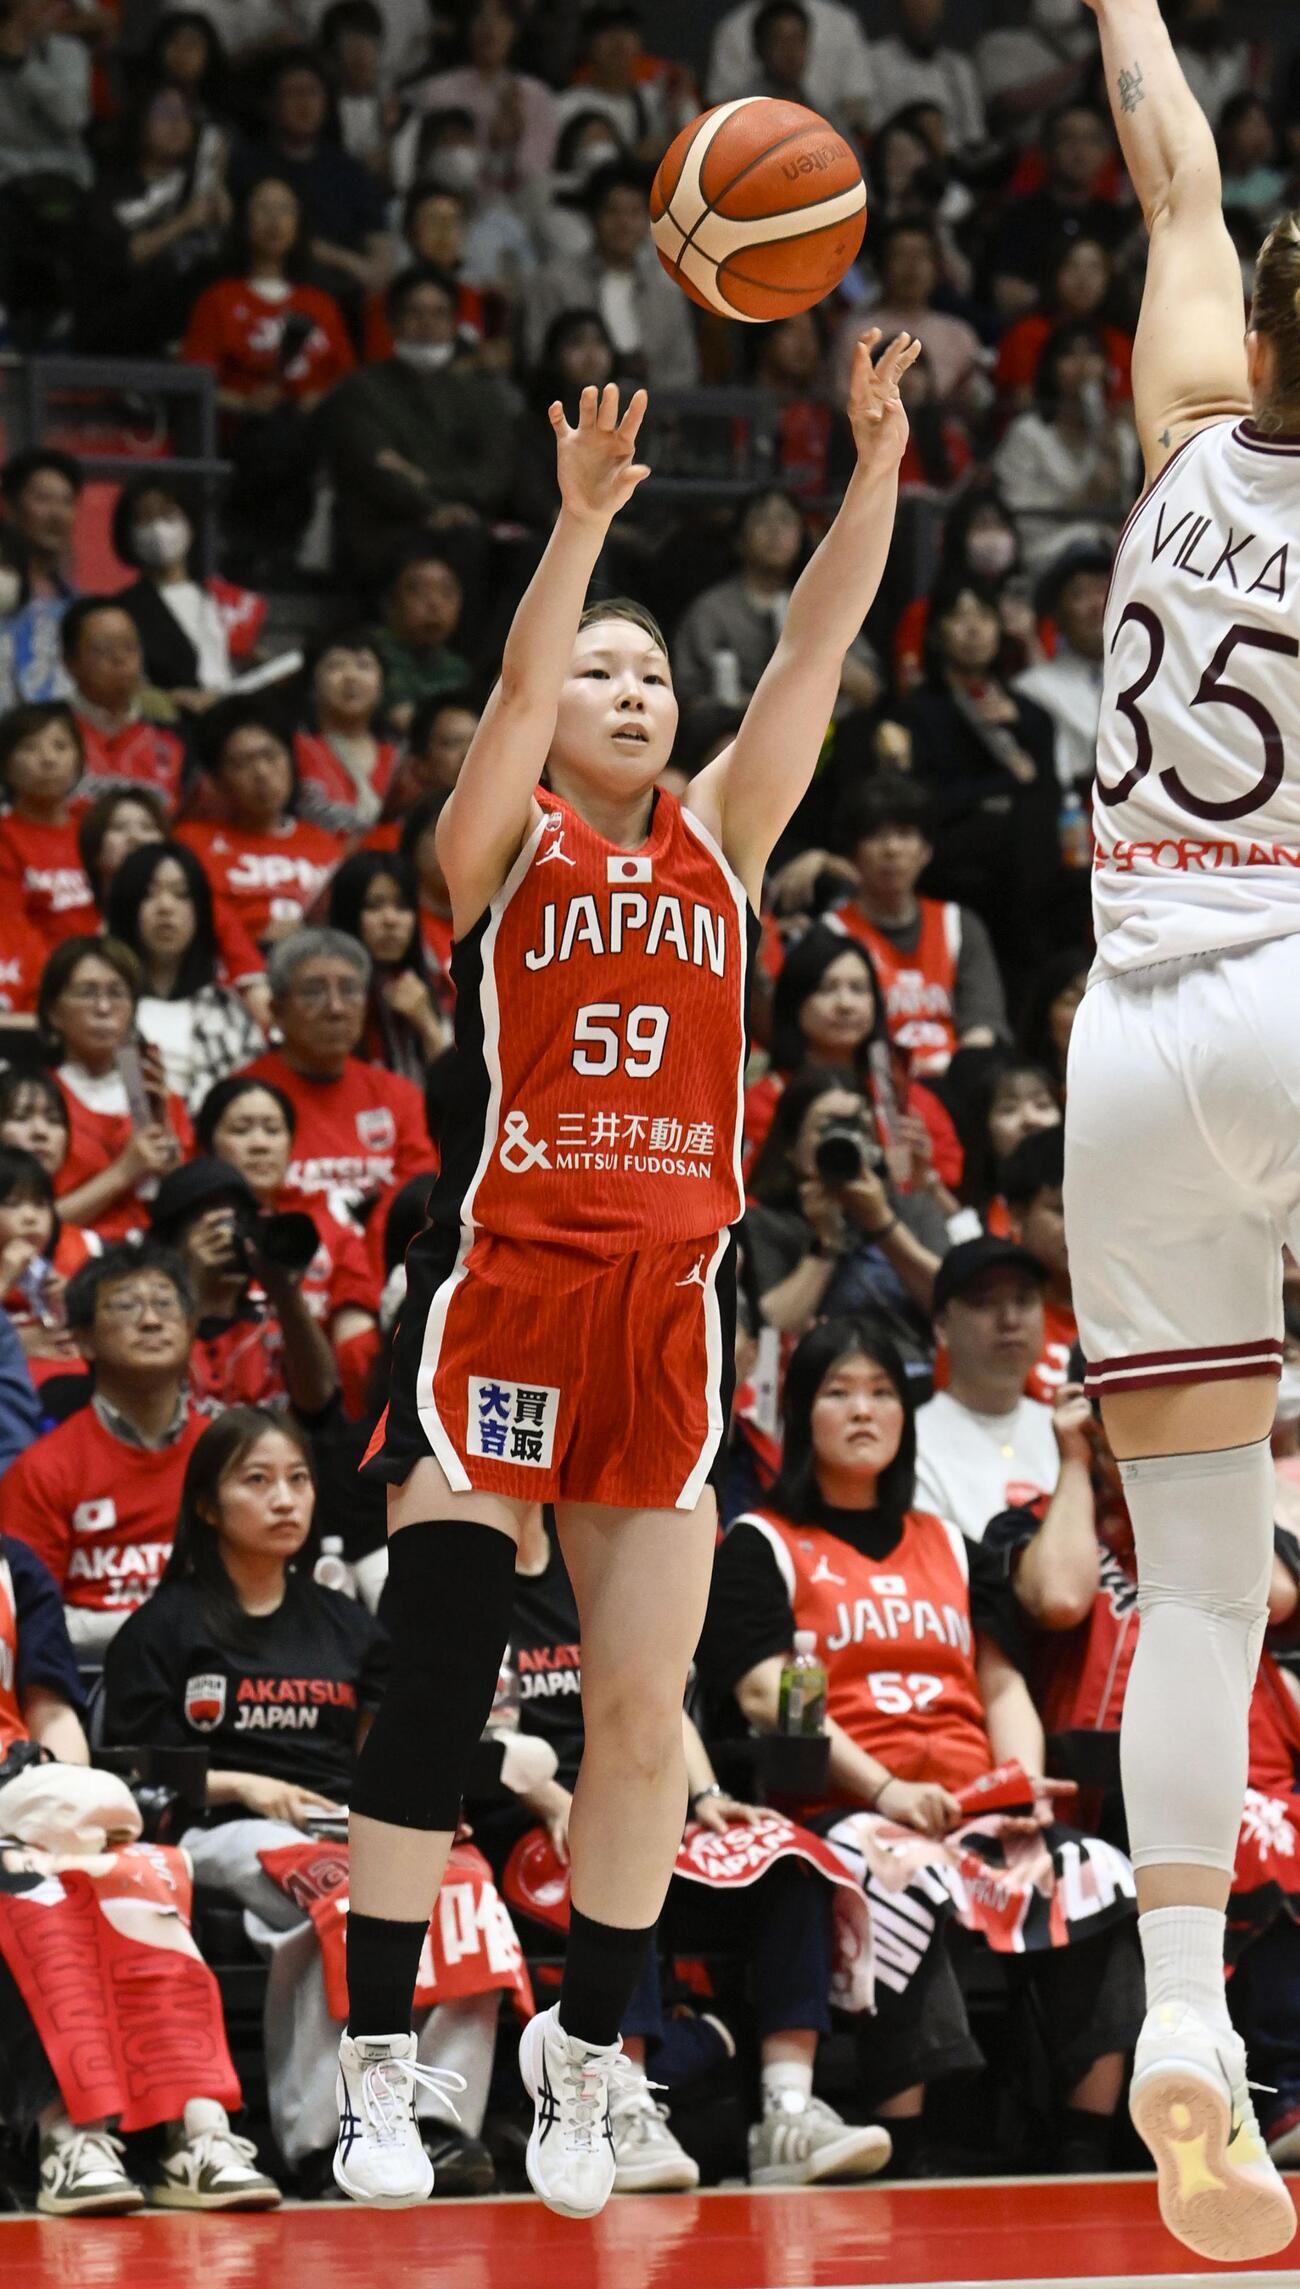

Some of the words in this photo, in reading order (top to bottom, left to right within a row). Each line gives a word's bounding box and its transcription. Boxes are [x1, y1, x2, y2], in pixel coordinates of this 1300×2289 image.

[1152, 503, 1289, 602] VILKA
[1096, 602, 1299, 821] 35
[523, 890, 726, 979] JAPAN
[571, 1001, 671, 1079] 59
[555, 1111, 715, 1156] 三井不動産
[555, 1152, 618, 1171] MITSUI
[623, 1155, 712, 1179] FUDOSAN
[479, 1383, 511, 1457] 大吉
[510, 1387, 548, 1463] 買取
[826, 1596, 972, 1656] JAPAN
[234, 1703, 319, 1730] JAPAN
[519, 1669, 580, 1699] JAPA
